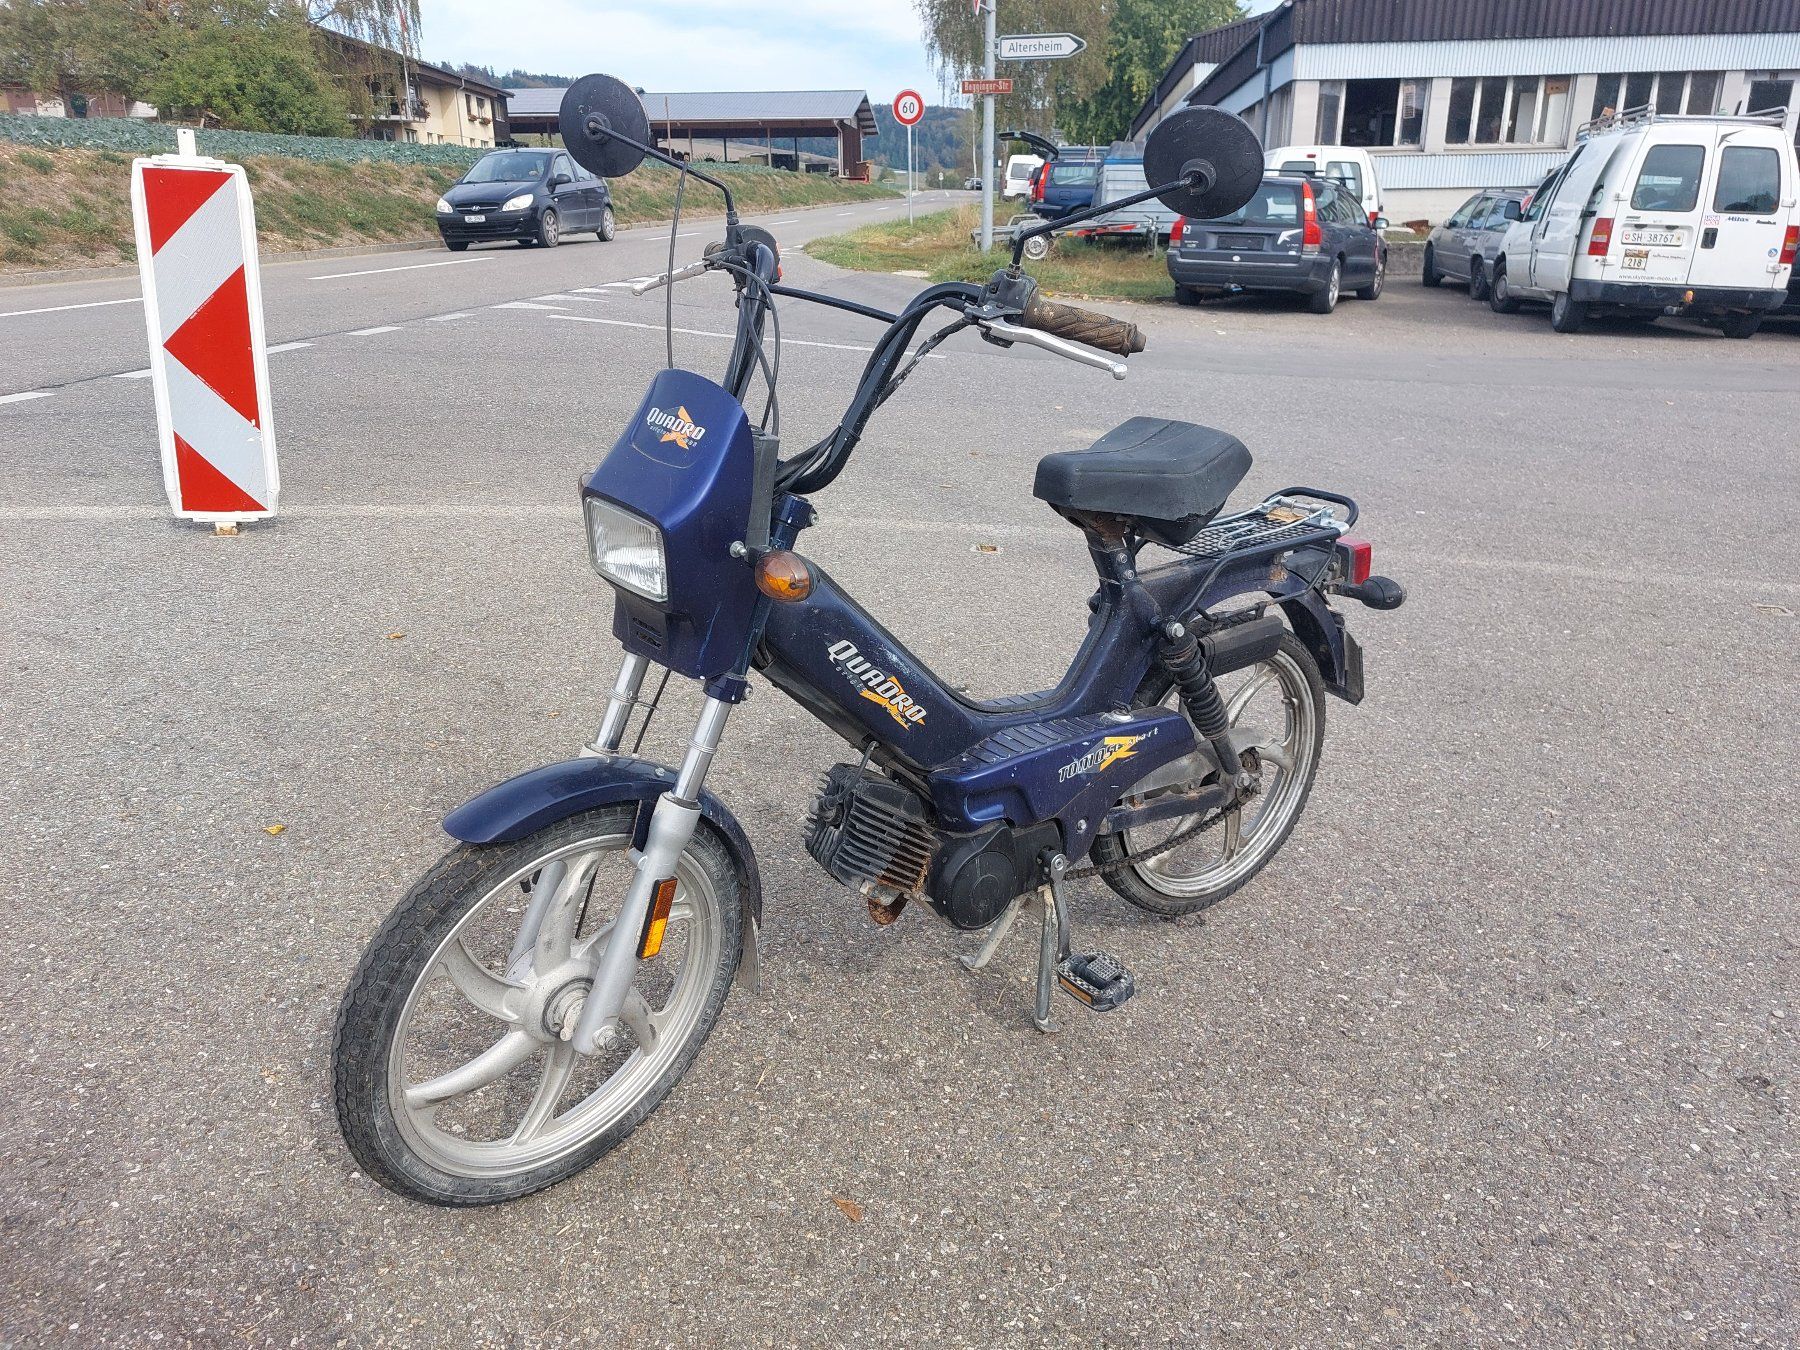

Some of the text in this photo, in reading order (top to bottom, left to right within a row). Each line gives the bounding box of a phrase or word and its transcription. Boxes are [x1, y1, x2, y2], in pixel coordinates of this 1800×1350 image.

[1008, 41, 1063, 53] Altersheim
[902, 102, 915, 114] 60
[1631, 232, 1675, 243] SH 38767
[1627, 258, 1643, 268] 218
[646, 407, 706, 441] QUADRO
[827, 639, 927, 722] QUADRO
[1058, 743, 1115, 783] TOMOS
